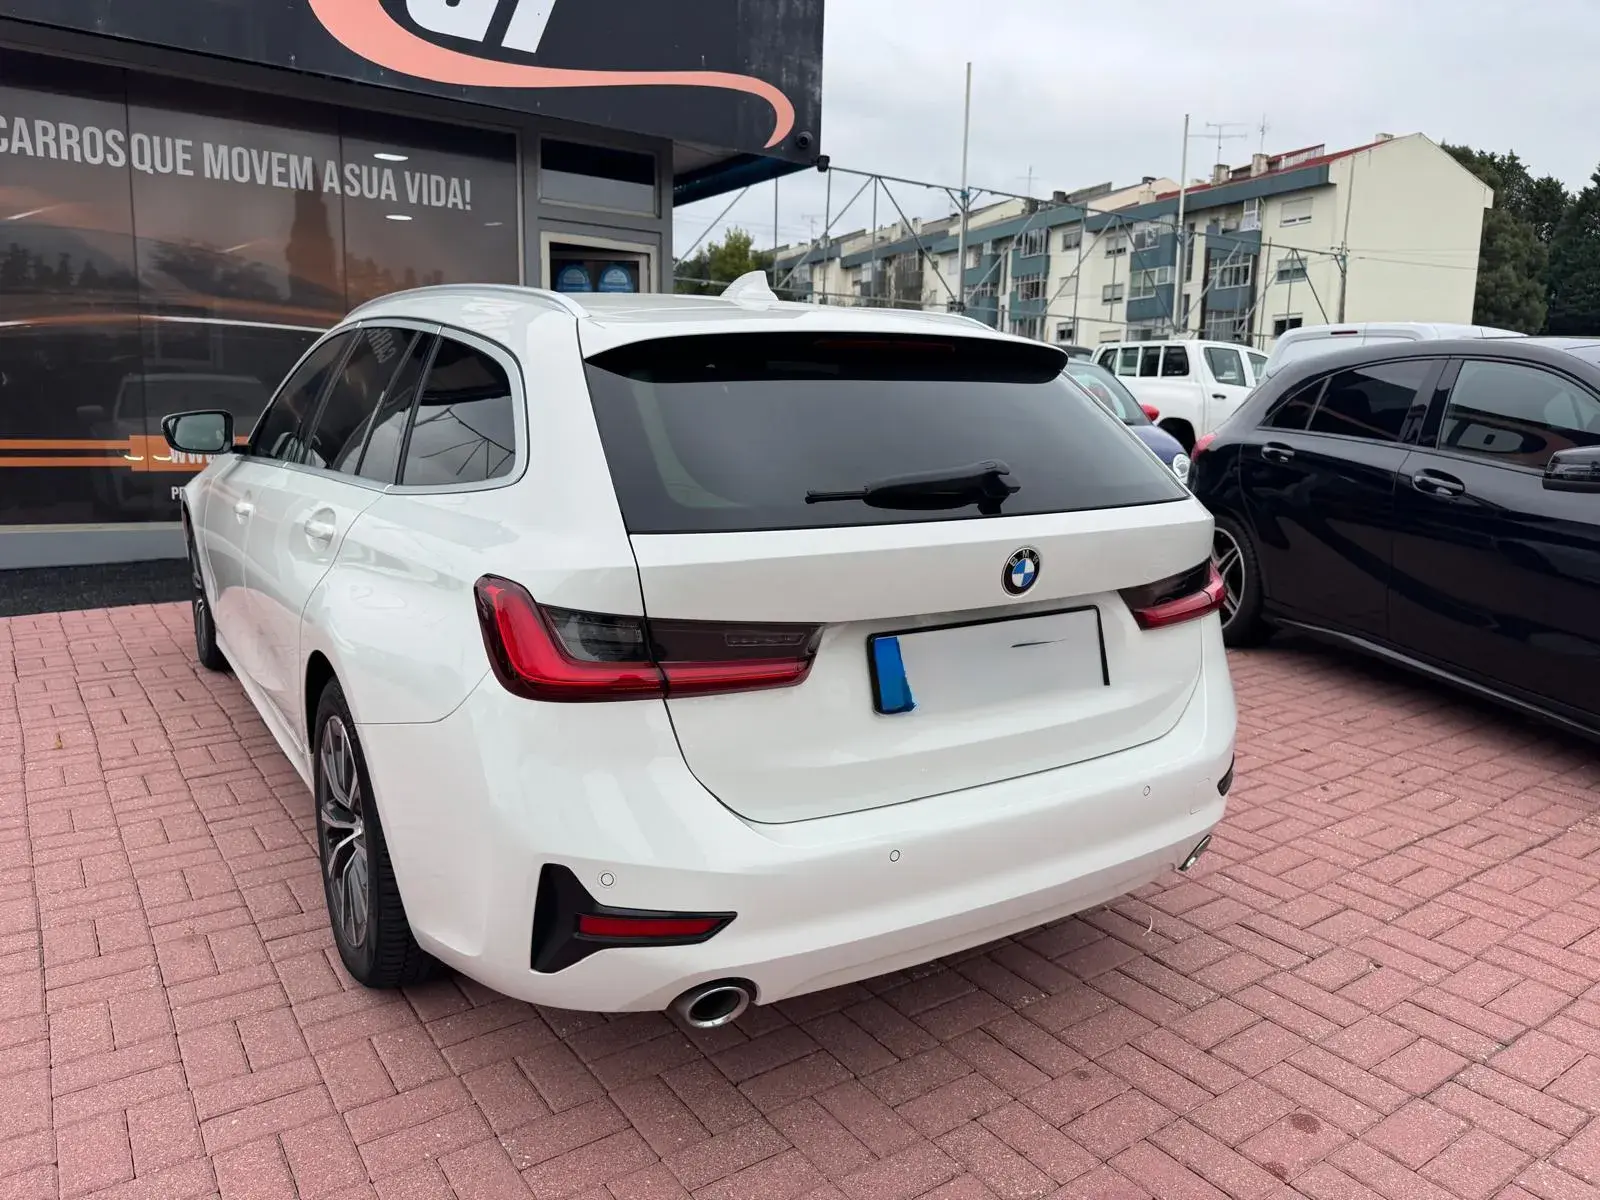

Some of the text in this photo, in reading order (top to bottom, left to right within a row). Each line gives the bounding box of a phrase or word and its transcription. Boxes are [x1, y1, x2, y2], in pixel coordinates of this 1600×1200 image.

[131, 133, 194, 176] QUE
[203, 142, 313, 191] MOVEM
[323, 160, 341, 194] A
[344, 163, 398, 201] SUA
[404, 170, 471, 210] VIDA!
